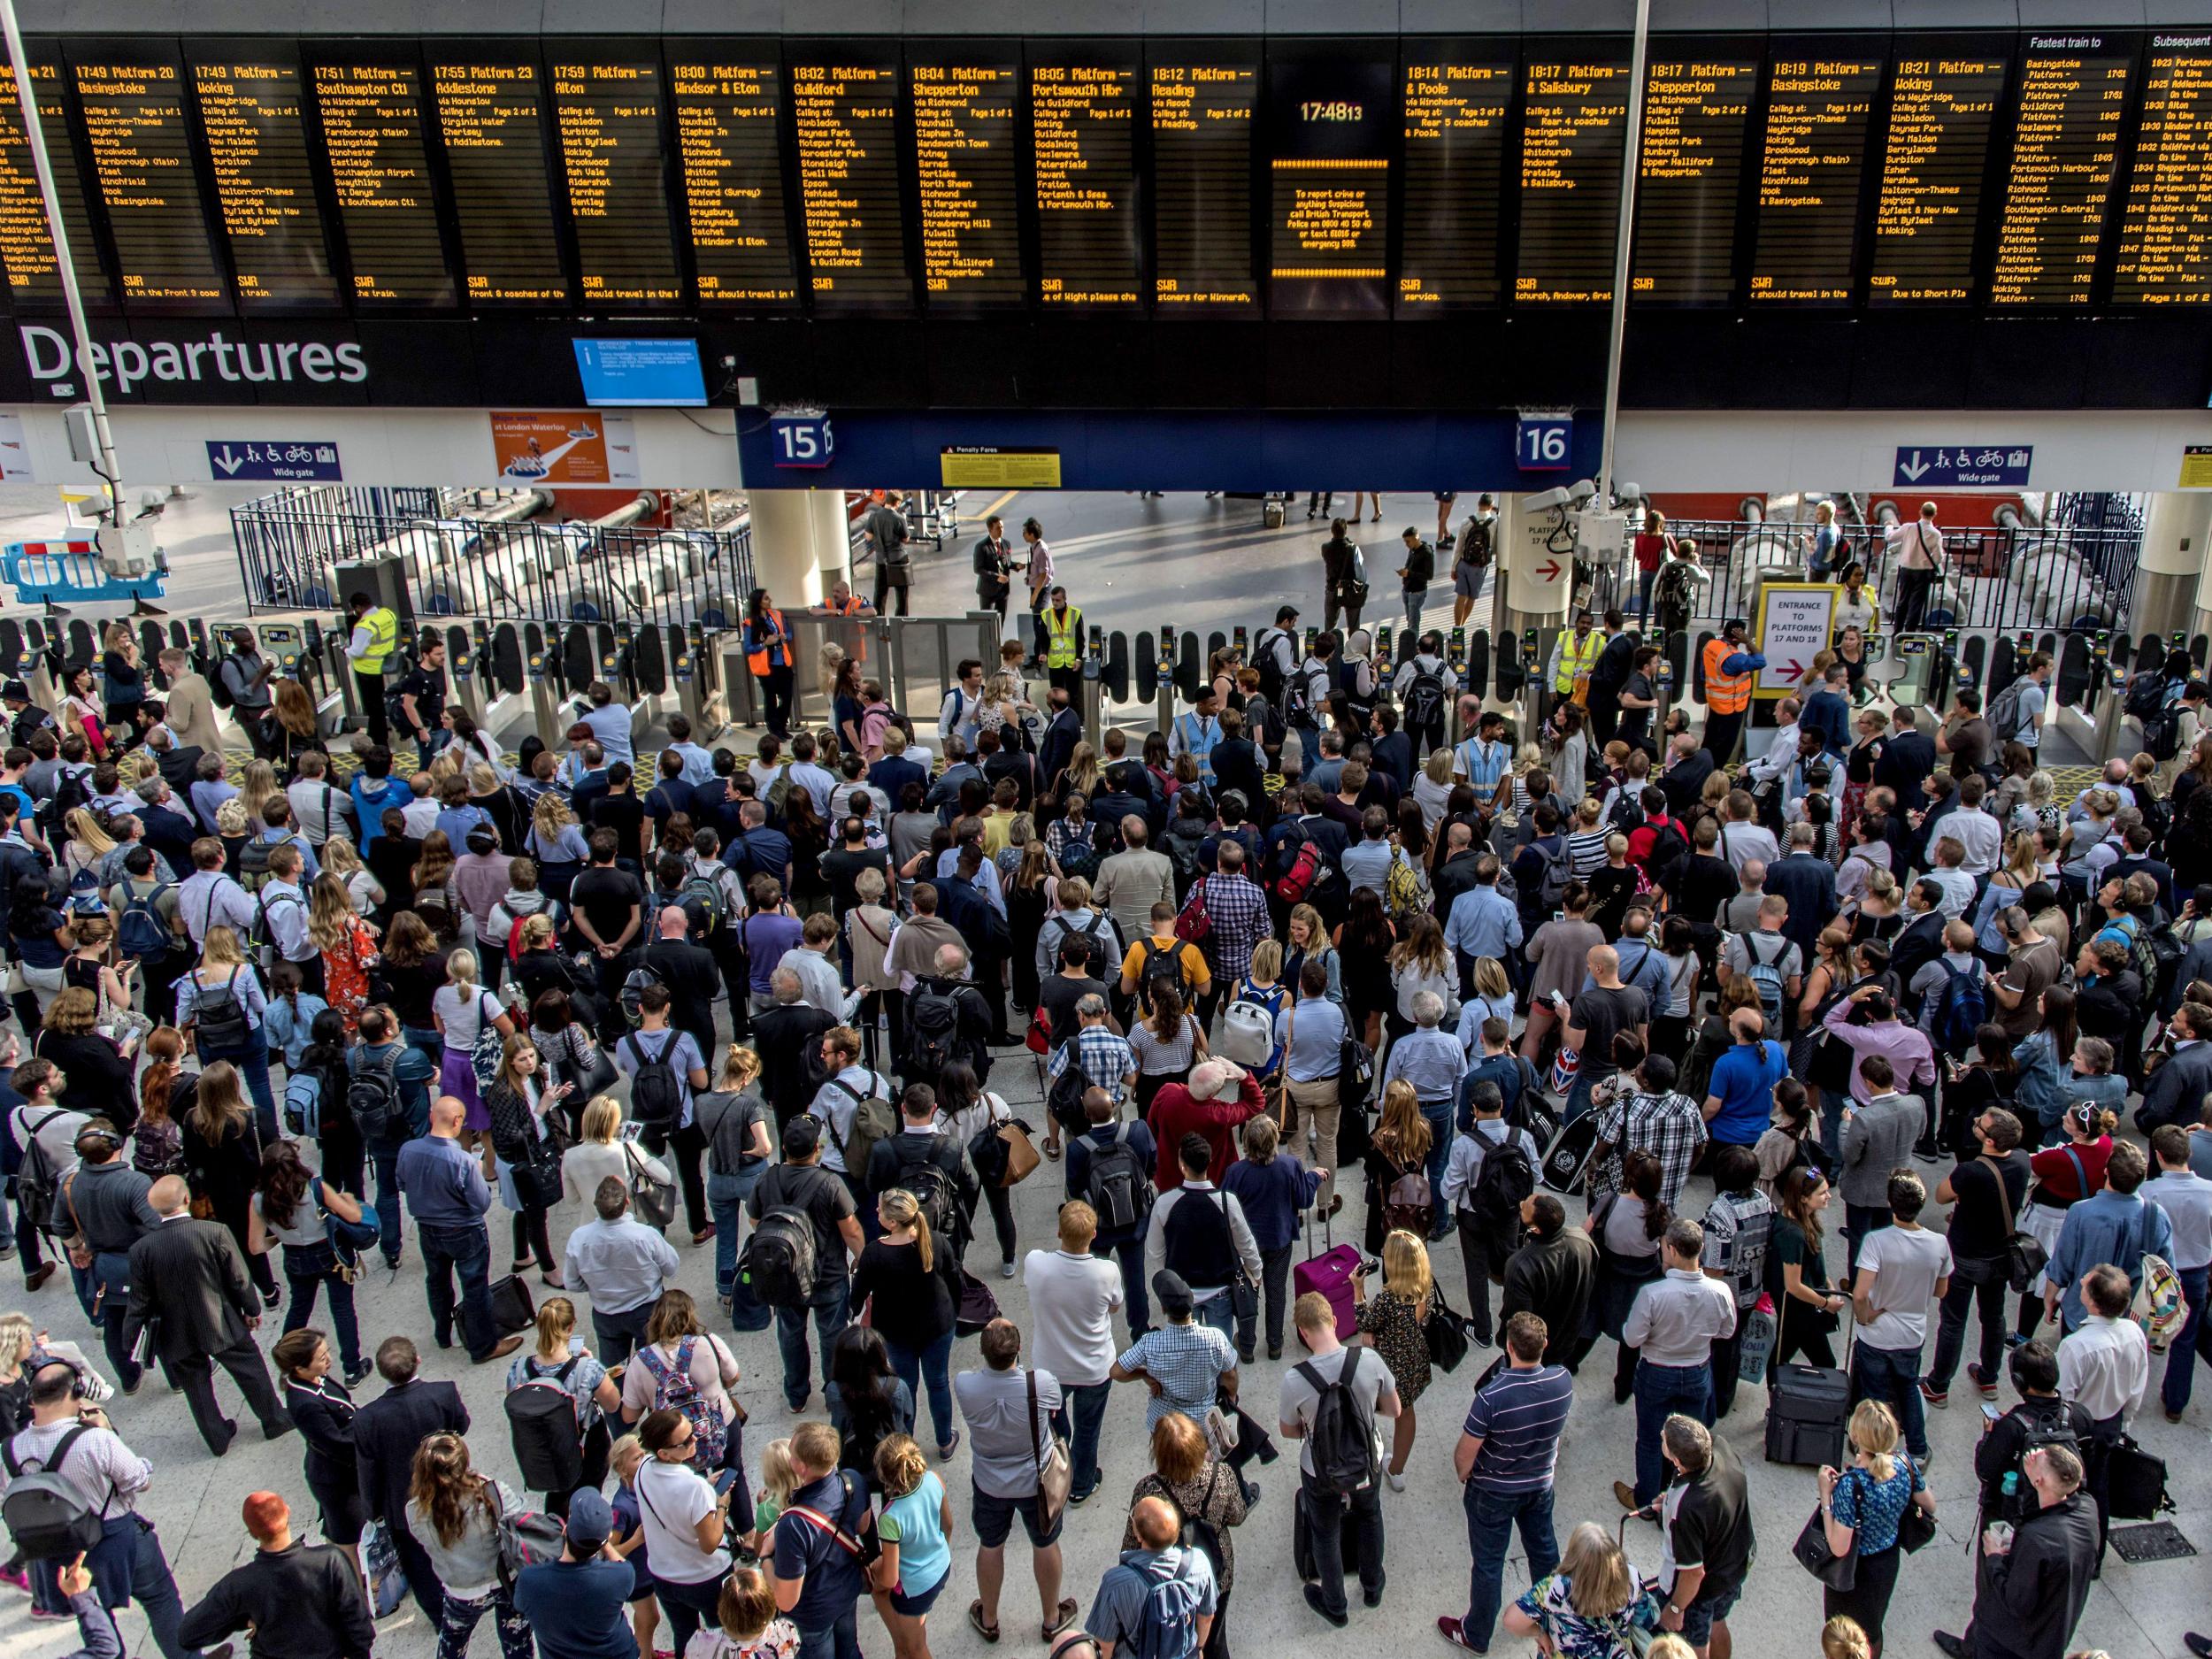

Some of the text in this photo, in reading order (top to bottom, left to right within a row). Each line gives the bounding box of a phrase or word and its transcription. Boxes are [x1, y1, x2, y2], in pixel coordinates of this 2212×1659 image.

[2031, 37, 2101, 48] Fastest train to
[2153, 35, 2211, 49] Subsequent
[40, 65, 56, 78] 21
[75, 65, 174, 78] 17:49 Platform 20
[196, 65, 279, 78] 17:49 Platform
[314, 66, 397, 79] 17:51 Platform
[434, 65, 533, 78] 17:55 Platform 23
[554, 65, 637, 78] 17:59 Platform
[674, 65, 757, 78] 18:00 Platform
[794, 66, 877, 79] 18:02 Platform
[913, 67, 996, 80] 18:04 Platform
[1408, 66, 1492, 79] 18:14 Platform
[1530, 65, 1614, 78] 18:17 Platform
[1652, 64, 1736, 76] 18:17 Platform
[1775, 62, 1860, 74] 18:19 Platform
[1899, 61, 1985, 73] 18:21 Platform
[1153, 67, 1237, 81] 18:12 Platform
[78, 81, 146, 95] Basingstoke
[197, 81, 234, 95] Woking
[316, 82, 408, 96] Southampton Ctl
[435, 81, 496, 94] Addlestone
[555, 81, 585, 94] Alton
[674, 81, 718, 94] Windsor
[733, 81, 761, 94] Eton
[794, 82, 844, 95] Guildford
[912, 82, 979, 96] Shepperton
[1032, 83, 1123, 96] Portsmouth Hbr
[1151, 83, 1196, 97] Reading
[1417, 82, 1449, 95] Poole
[1539, 81, 1592, 95] Salisbury
[1648, 81, 1716, 94] Shepperton
[1770, 78, 1841, 92] Basingstoke
[1894, 78, 1933, 91] Woking
[122, 275, 144, 286] SWR
[812, 277, 833, 289] SWR
[1751, 276, 1773, 288] SWR
[20, 326, 367, 394] Departures
[779, 426, 818, 458] 15
[1526, 427, 1566, 461] 16
[273, 467, 314, 480] Wide gate
[1958, 473, 2000, 484] Wide gate
[1771, 624, 1823, 633] PLATFORMS
[1807, 635, 1817, 644] 18
